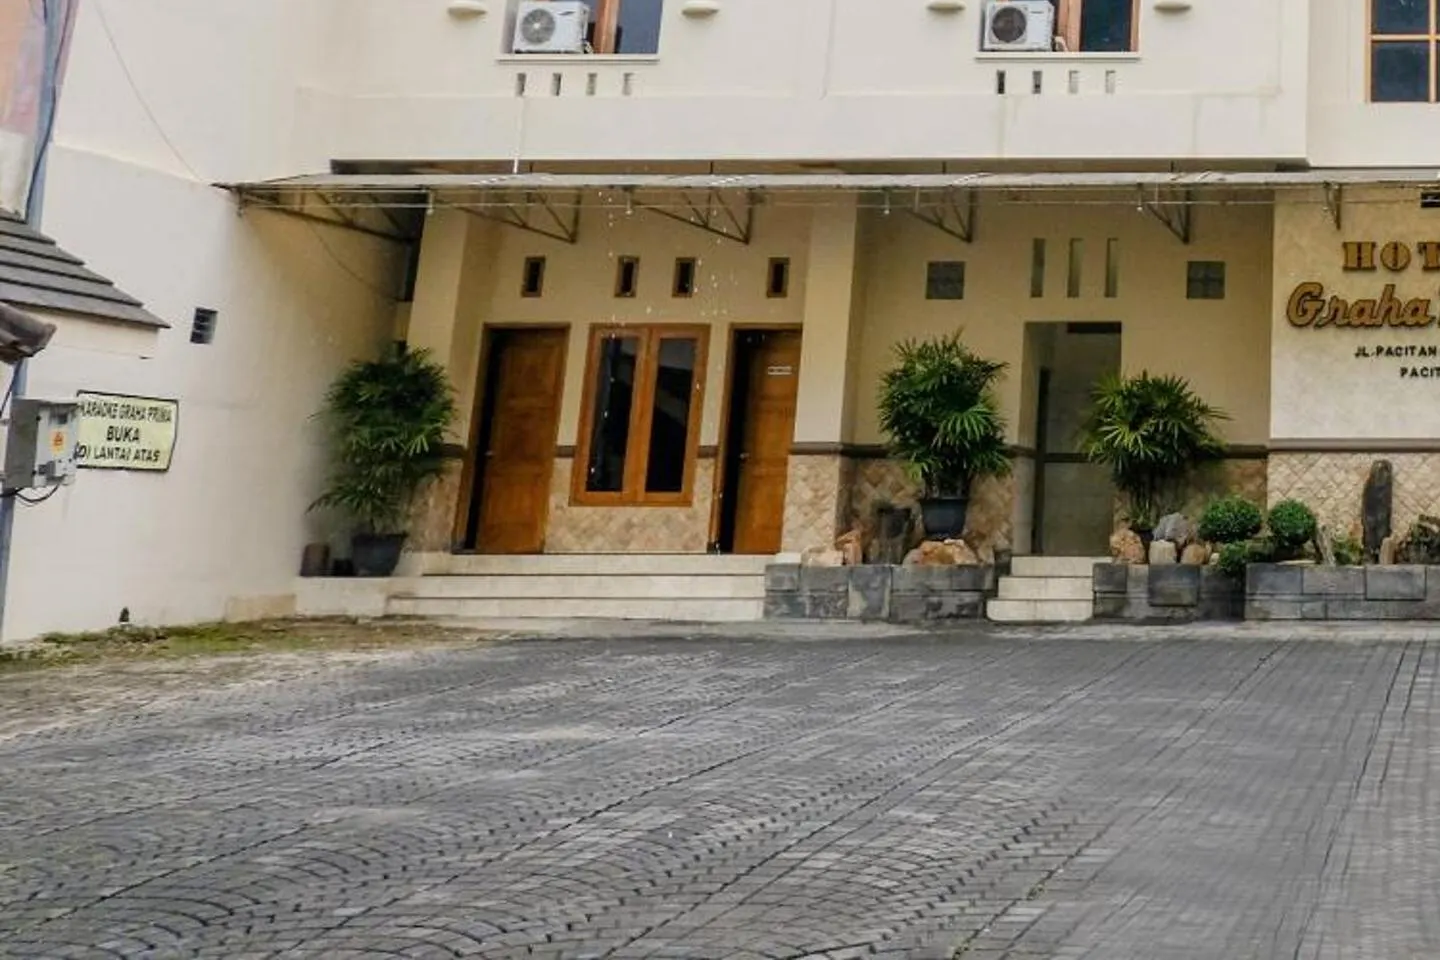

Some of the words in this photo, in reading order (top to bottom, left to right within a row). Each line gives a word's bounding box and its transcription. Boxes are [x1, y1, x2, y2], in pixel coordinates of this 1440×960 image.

[1286, 282, 1434, 329] Graha
[106, 426, 140, 442] BUKA
[93, 446, 132, 461] LANTAI
[133, 449, 161, 462] ATAS
